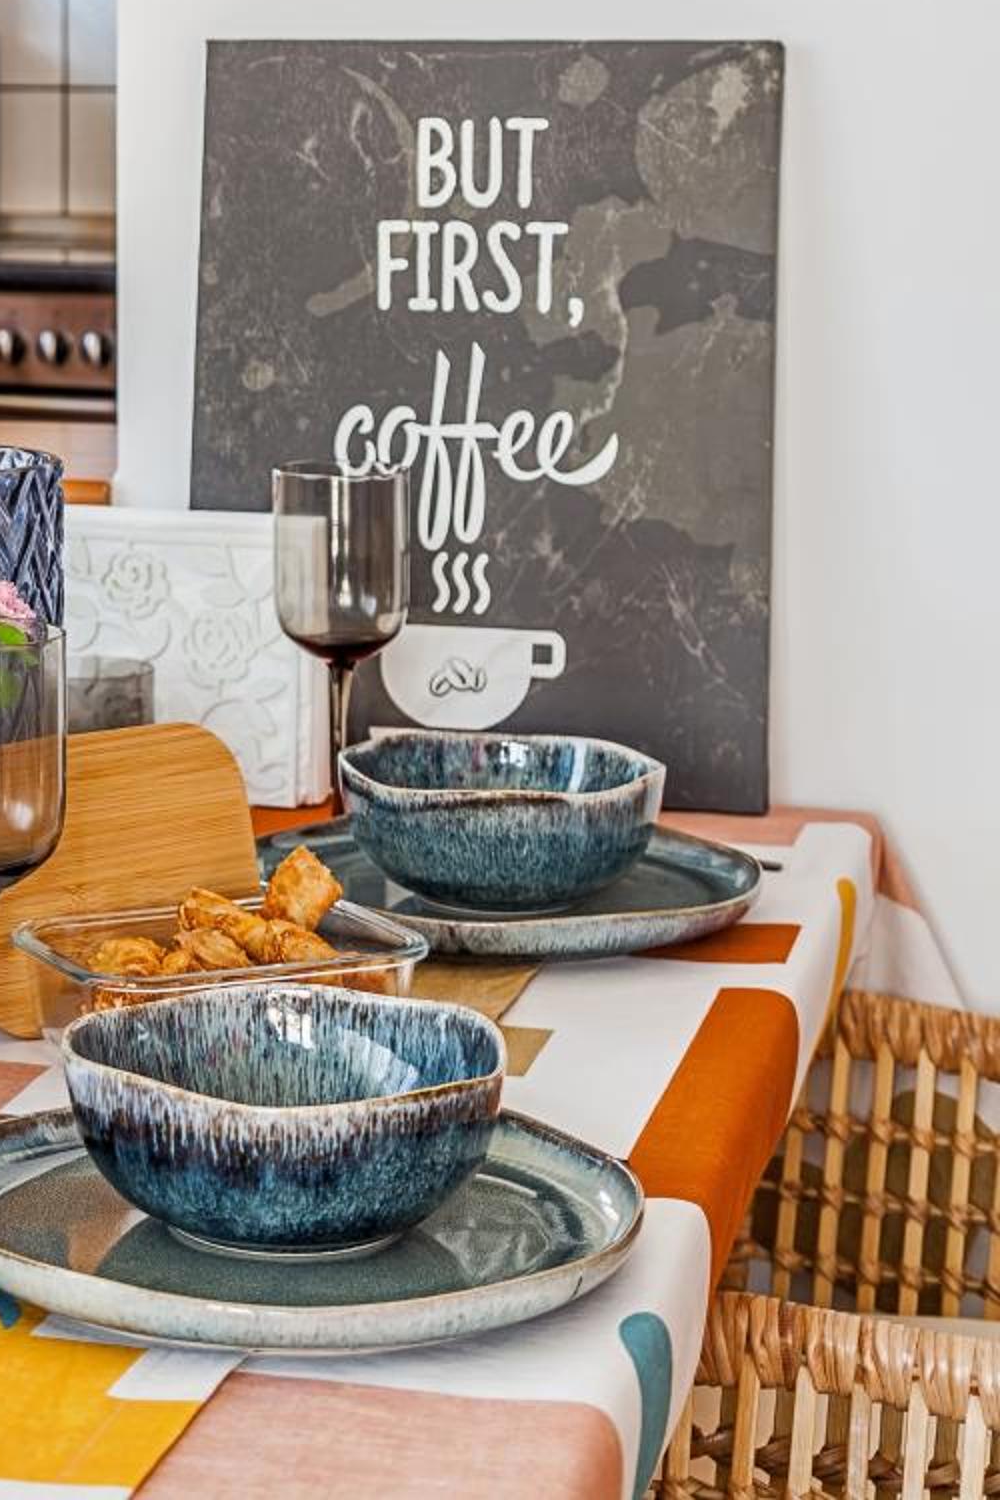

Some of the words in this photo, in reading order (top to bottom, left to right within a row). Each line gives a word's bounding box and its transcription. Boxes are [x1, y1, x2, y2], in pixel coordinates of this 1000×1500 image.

[416, 116, 549, 208] BUT
[377, 219, 585, 328] FIRST,
[334, 342, 619, 550] coffee
